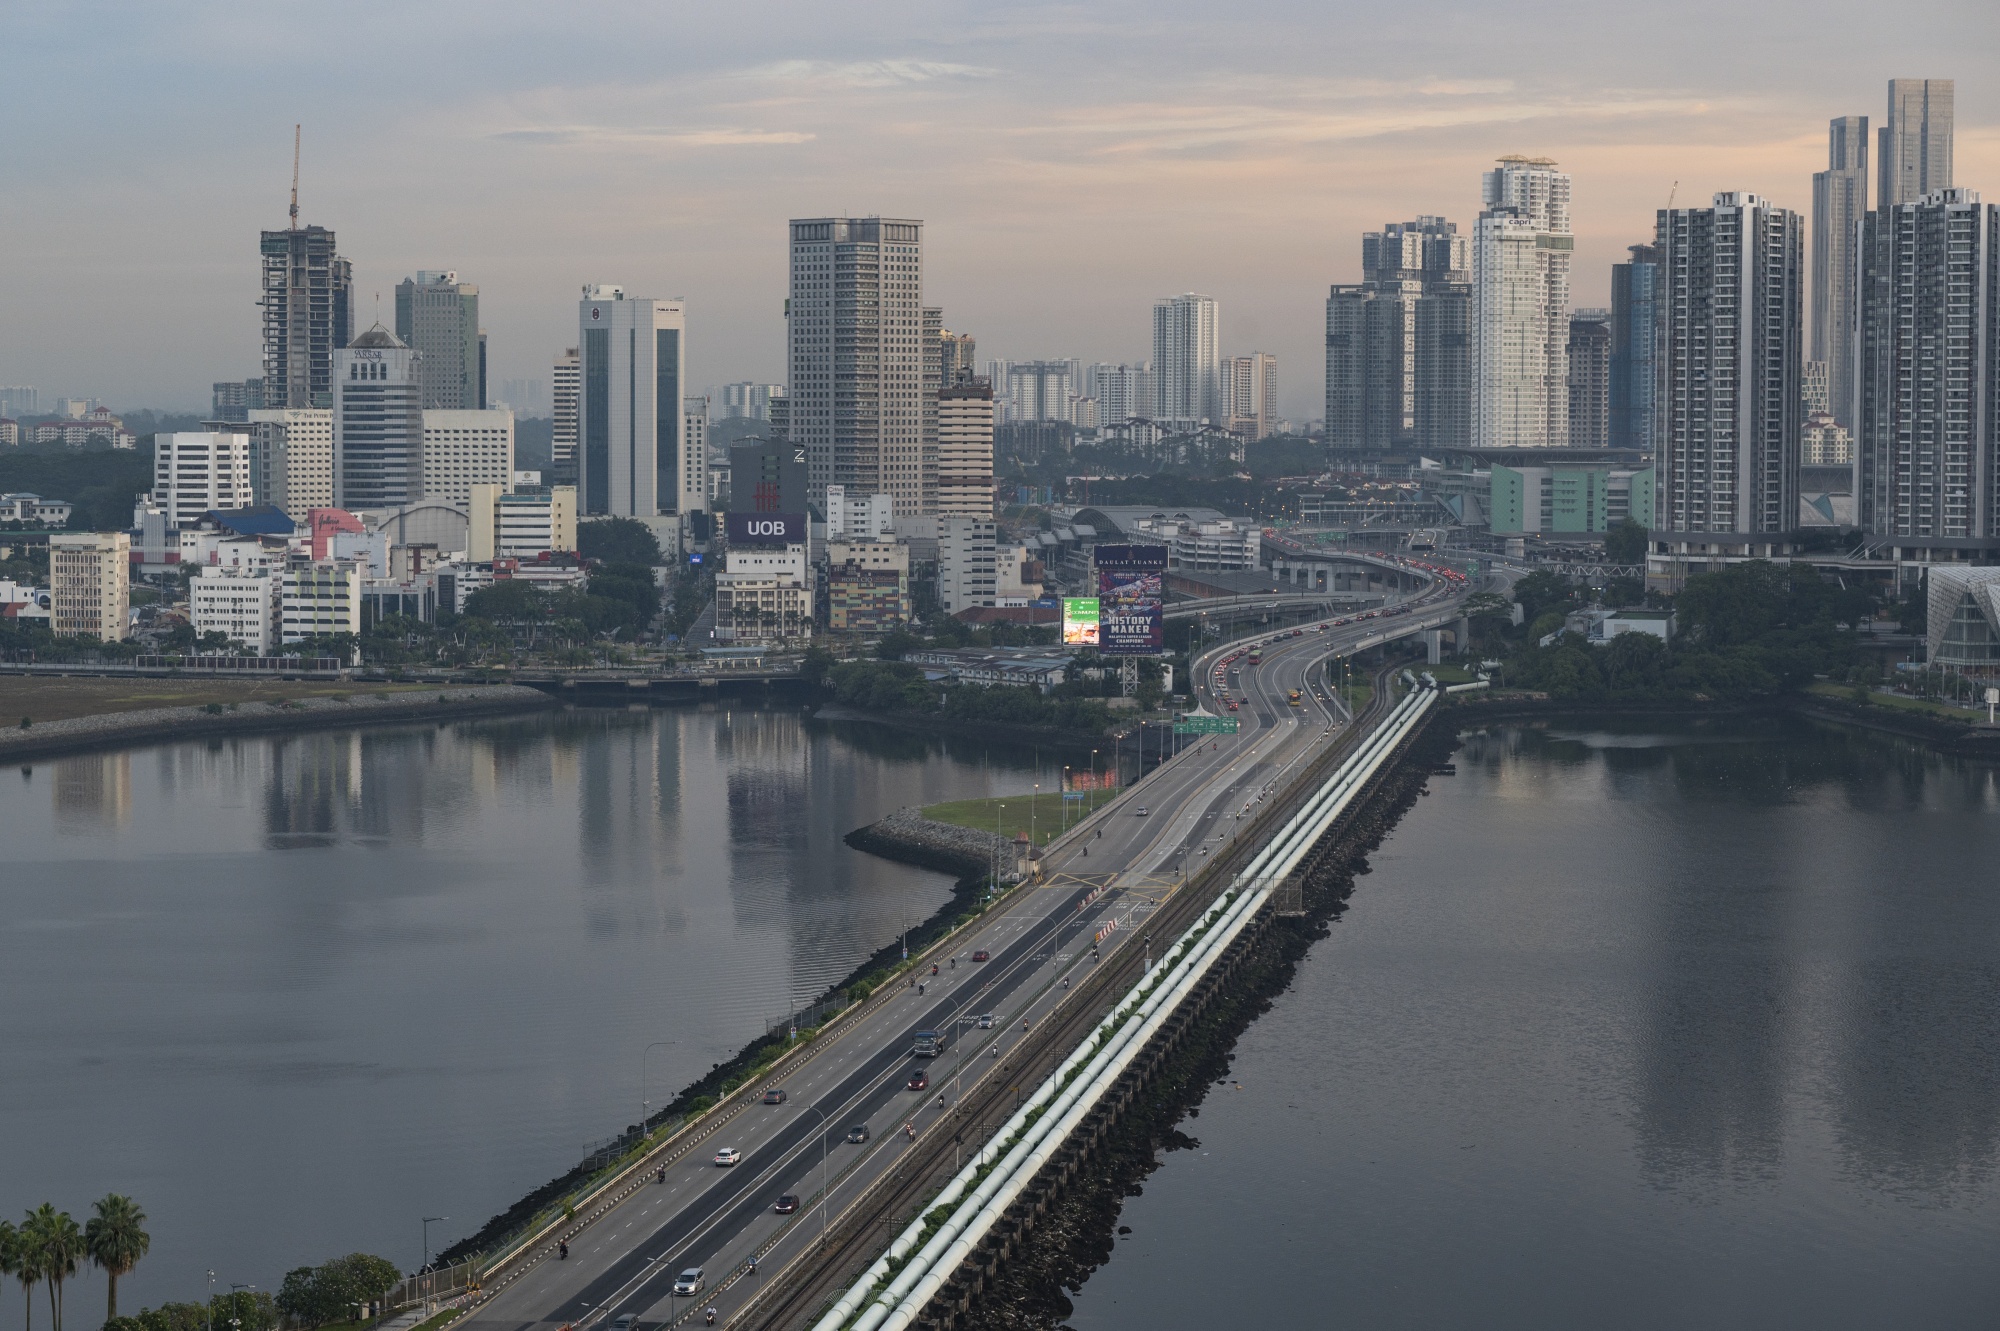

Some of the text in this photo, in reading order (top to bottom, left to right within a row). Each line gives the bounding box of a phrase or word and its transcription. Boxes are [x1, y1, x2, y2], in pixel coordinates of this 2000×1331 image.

[1509, 218, 1530, 226] capri
[748, 521, 785, 535] UOB
[1111, 625, 1150, 633] MAKER
